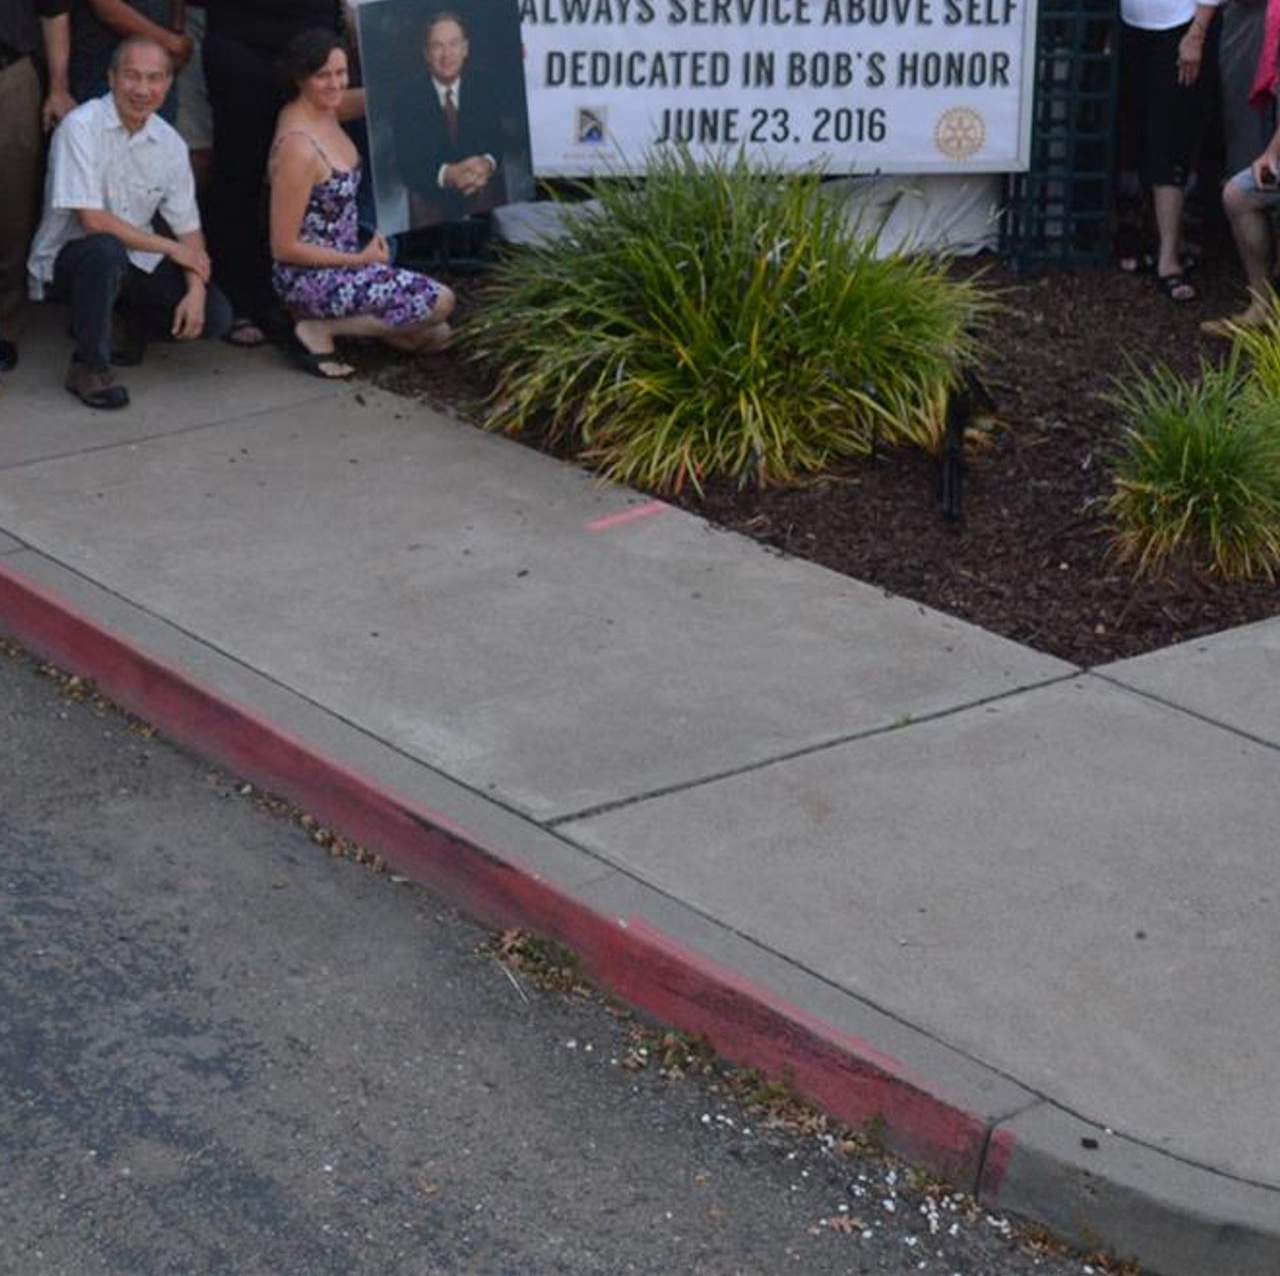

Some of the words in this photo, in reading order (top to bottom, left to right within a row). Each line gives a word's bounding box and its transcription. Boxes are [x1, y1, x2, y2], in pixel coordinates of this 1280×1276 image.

[544, 50, 731, 88] DEDICATED
[741, 51, 776, 88] IN
[786, 51, 886, 89] BOB'S
[896, 51, 1012, 89] HONOR
[654, 107, 739, 145] JUNE
[811, 107, 887, 143] 2016
